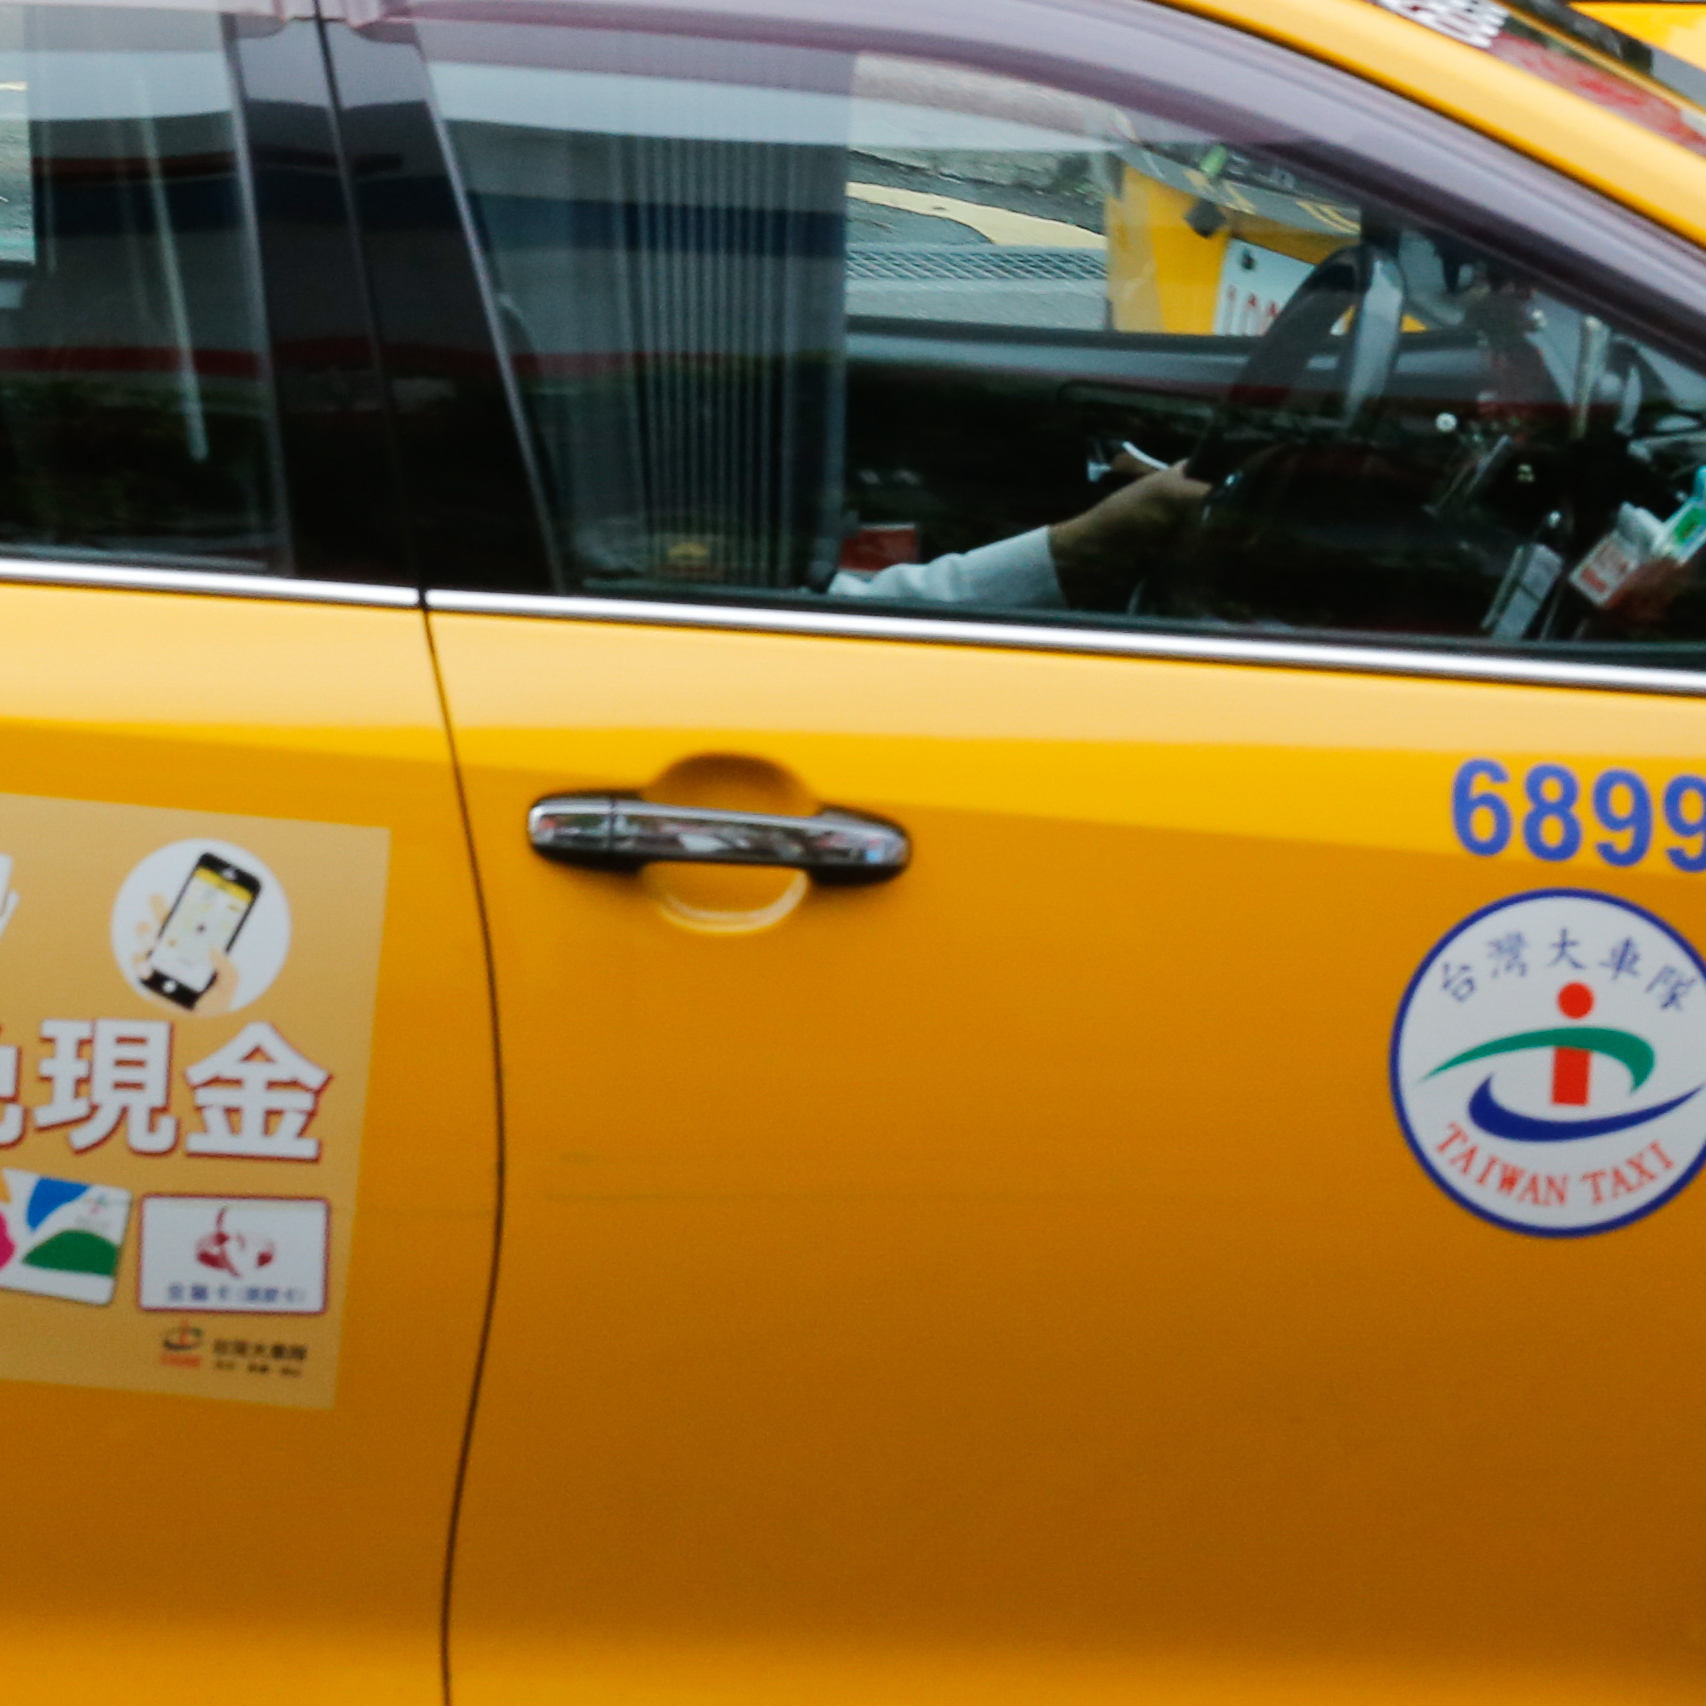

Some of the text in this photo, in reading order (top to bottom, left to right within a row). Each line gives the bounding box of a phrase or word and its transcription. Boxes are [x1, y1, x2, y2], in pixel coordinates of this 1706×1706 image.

[1450, 757, 1706, 873] 6899
[1441, 927, 1696, 1011] 台灣大車隊
[1435, 1122, 1675, 1207] TAIWAN TAXI
